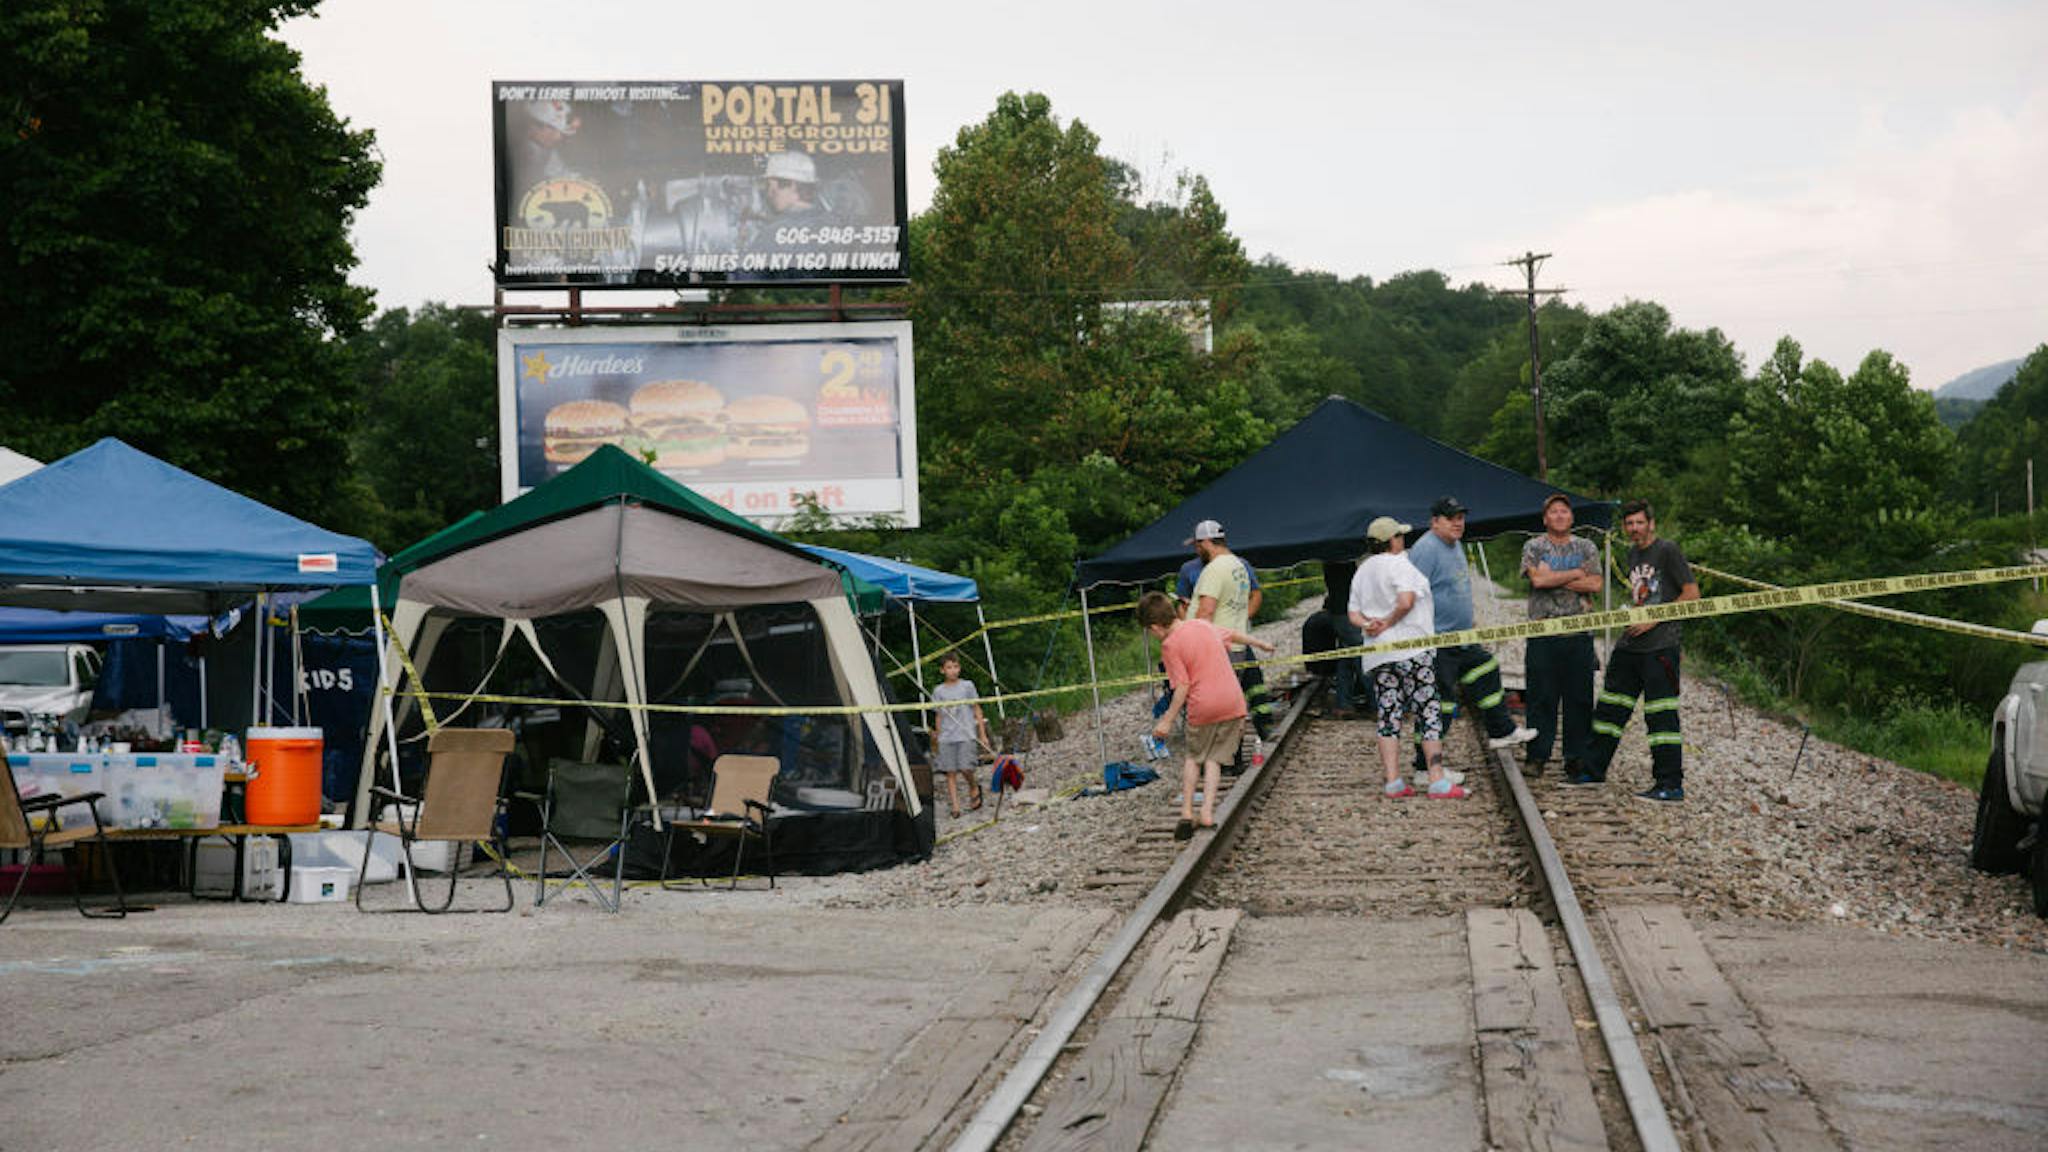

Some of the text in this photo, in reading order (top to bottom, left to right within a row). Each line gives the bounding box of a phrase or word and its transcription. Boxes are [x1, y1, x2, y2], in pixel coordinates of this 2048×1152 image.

[500, 87, 537, 101] DON'T
[538, 87, 573, 100] LEAVE
[574, 86, 627, 100] WITHOUT
[701, 82, 890, 126] PORTAL 31
[704, 125, 891, 140] UNDERGROUND
[705, 139, 891, 154] MINE TOUR
[690, 254, 739, 271] MILES
[743, 254, 769, 270] ON
[769, 254, 793, 270] KY
[796, 253, 827, 270] 160
[830, 253, 851, 269] IN
[852, 252, 900, 270] LYNCH
[549, 353, 645, 378] Hardee's
[743, 490, 779, 511] on
